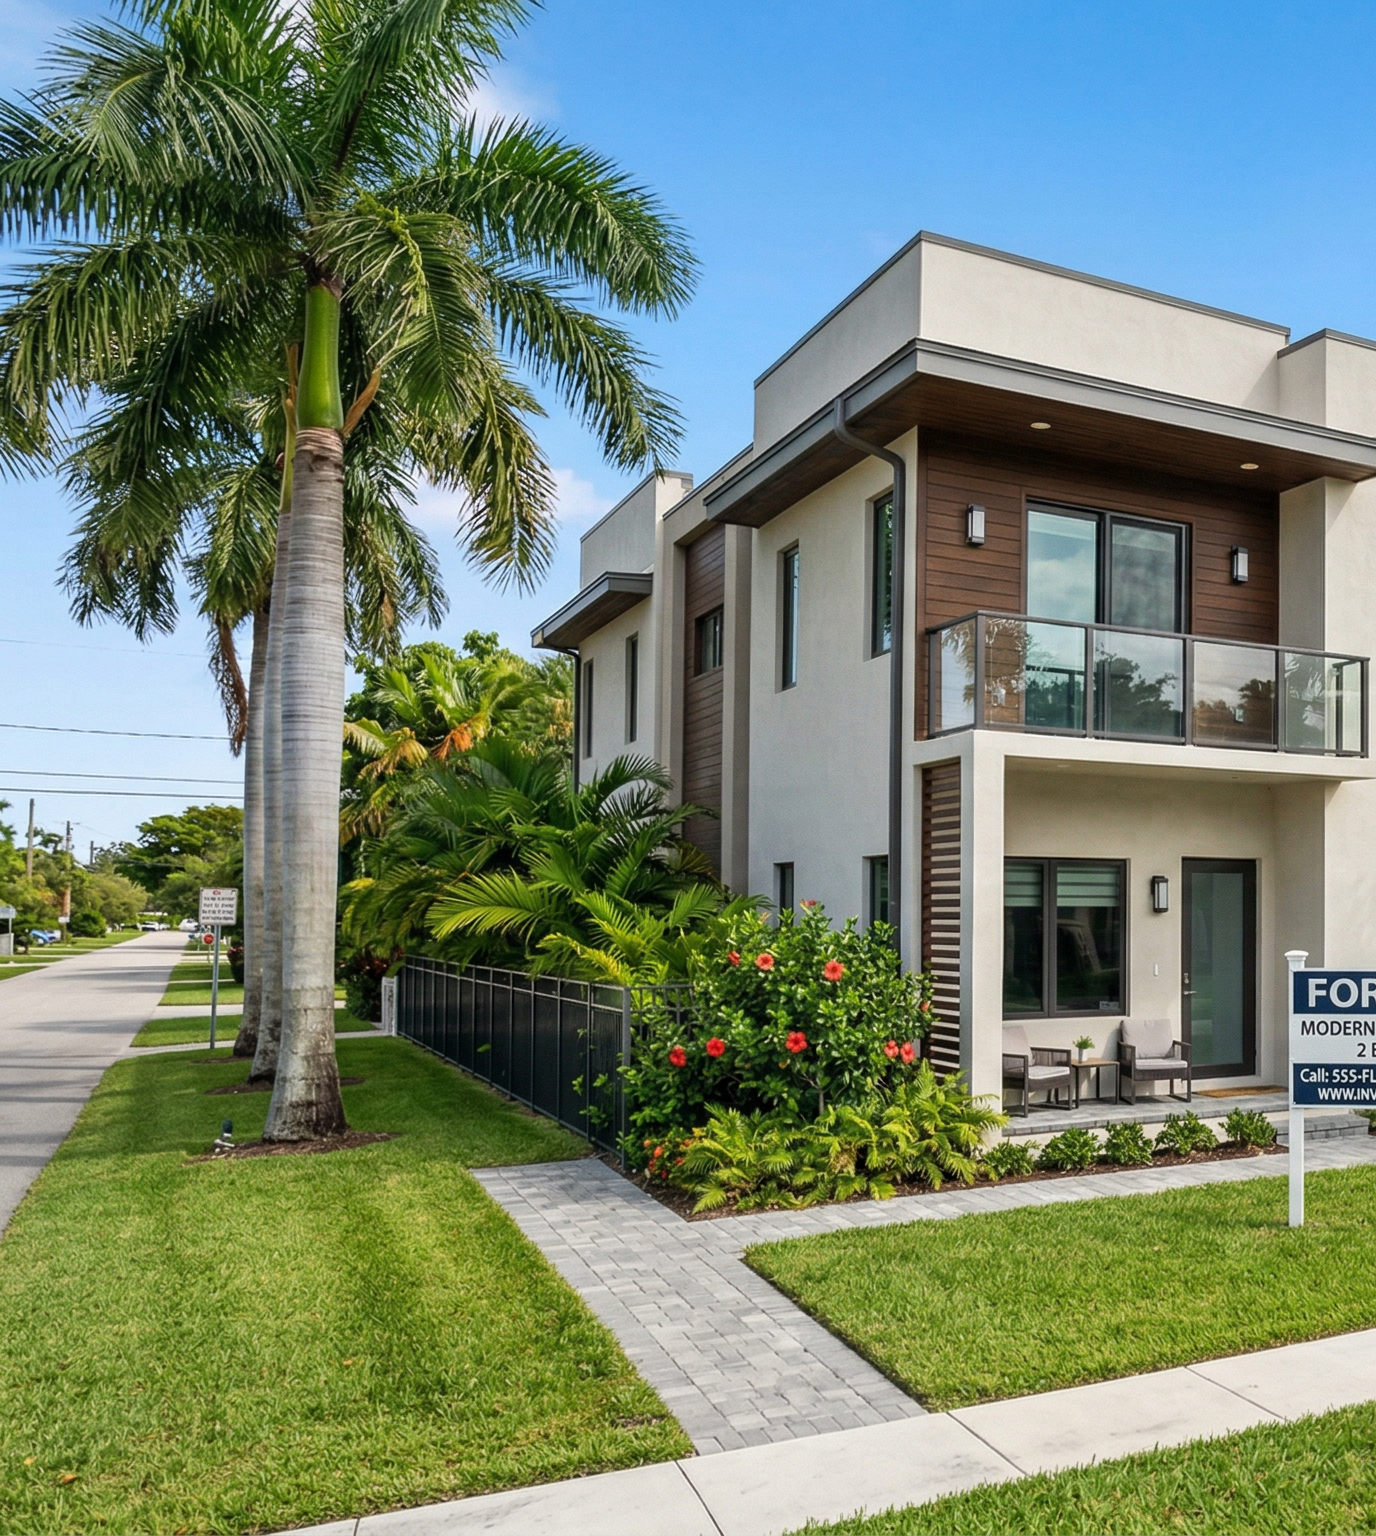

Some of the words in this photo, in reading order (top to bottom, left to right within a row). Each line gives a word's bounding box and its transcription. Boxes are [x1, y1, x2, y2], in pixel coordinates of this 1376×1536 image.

[1301, 1020, 1375, 1036] MODERN
[1356, 1042, 1367, 1058] 2
[1300, 1068, 1330, 1083] Call:
